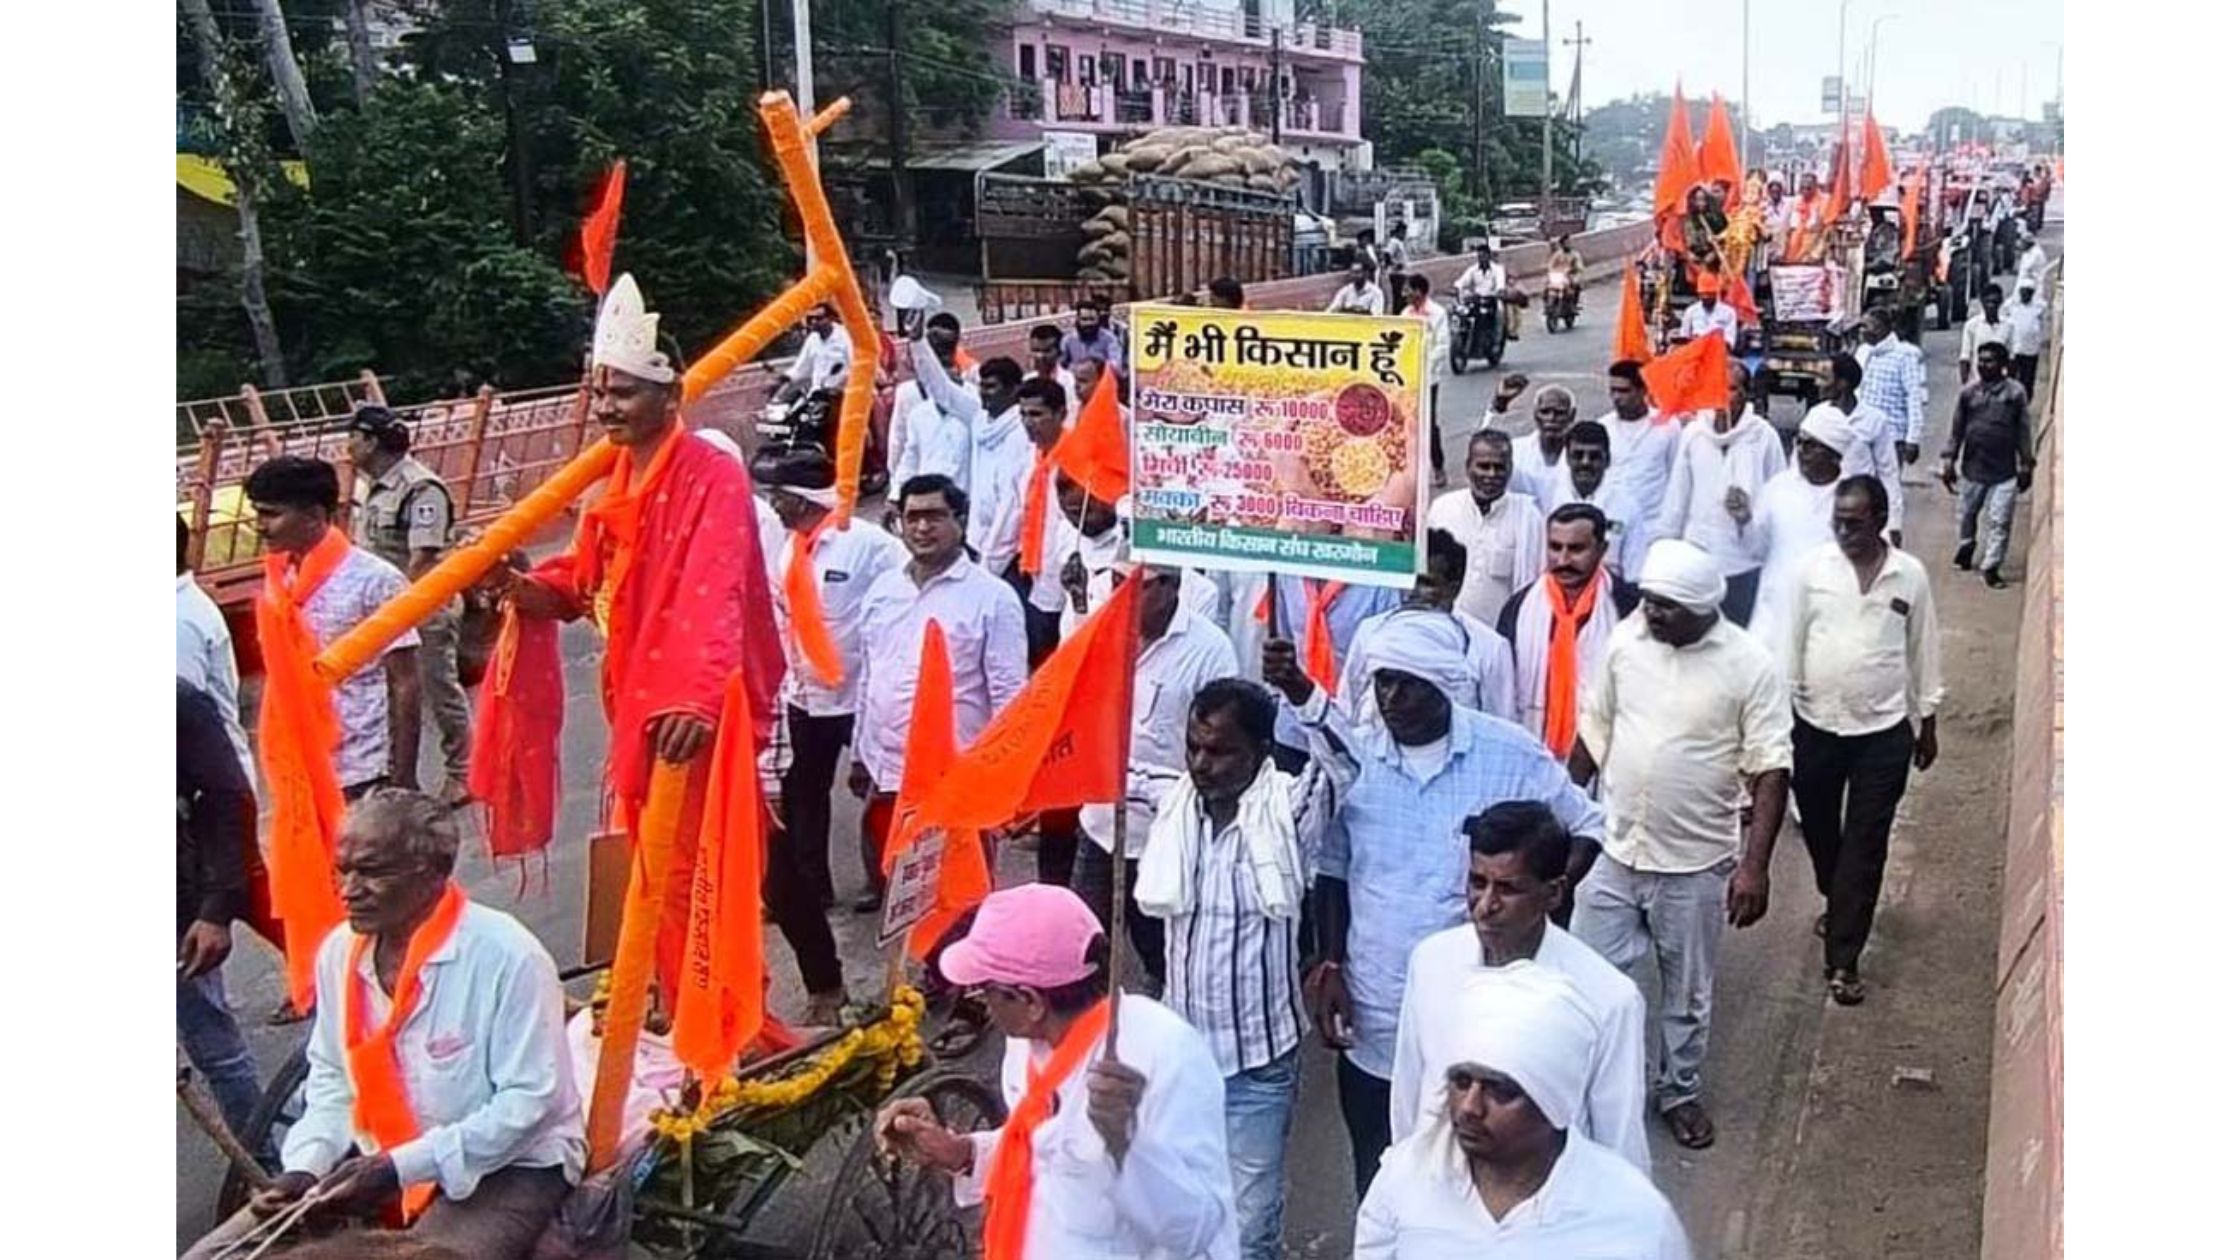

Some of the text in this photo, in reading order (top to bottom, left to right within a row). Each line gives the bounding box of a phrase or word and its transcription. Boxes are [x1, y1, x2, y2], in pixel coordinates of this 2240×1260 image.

[1144, 321, 1405, 386] मैं भी किसान हूँ
[1142, 391, 1179, 411] मेरा
[1183, 396, 1244, 415] कपास
[1281, 401, 1328, 420] 10000
[1142, 424, 1228, 446] सोयाबीन
[1263, 432, 1303, 451] 6000
[1237, 494, 1276, 515] 3000
[1157, 526, 1217, 548] भारतीय
[1220, 528, 1277, 554] किसान
[1279, 534, 1309, 557] संघ
